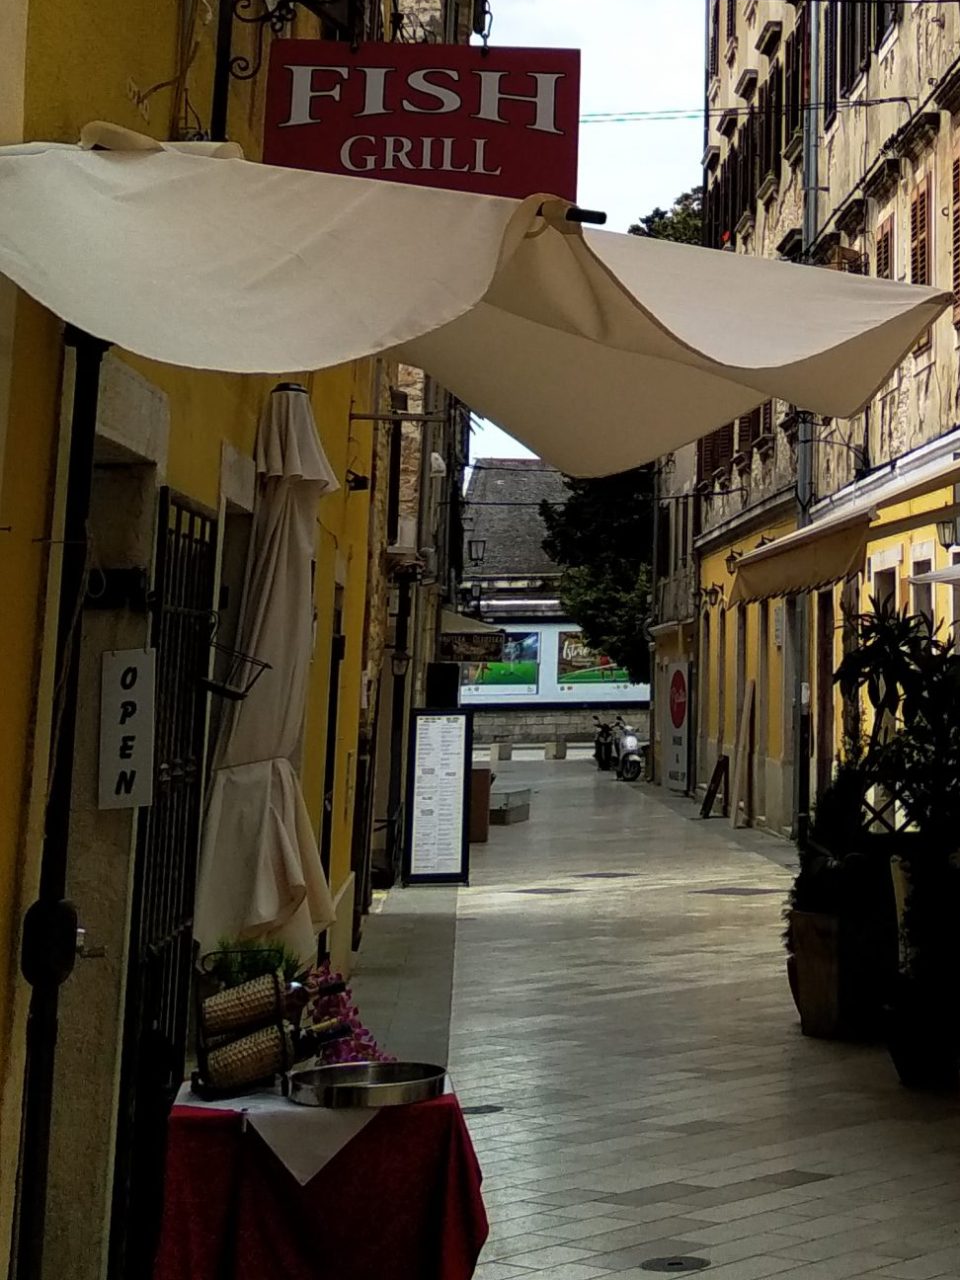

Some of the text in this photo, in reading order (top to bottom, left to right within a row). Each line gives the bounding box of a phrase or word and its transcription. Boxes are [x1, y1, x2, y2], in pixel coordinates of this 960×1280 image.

[278, 65, 566, 135] FISH
[340, 135, 502, 176] GRILL
[114, 666, 138, 796] OPEN
